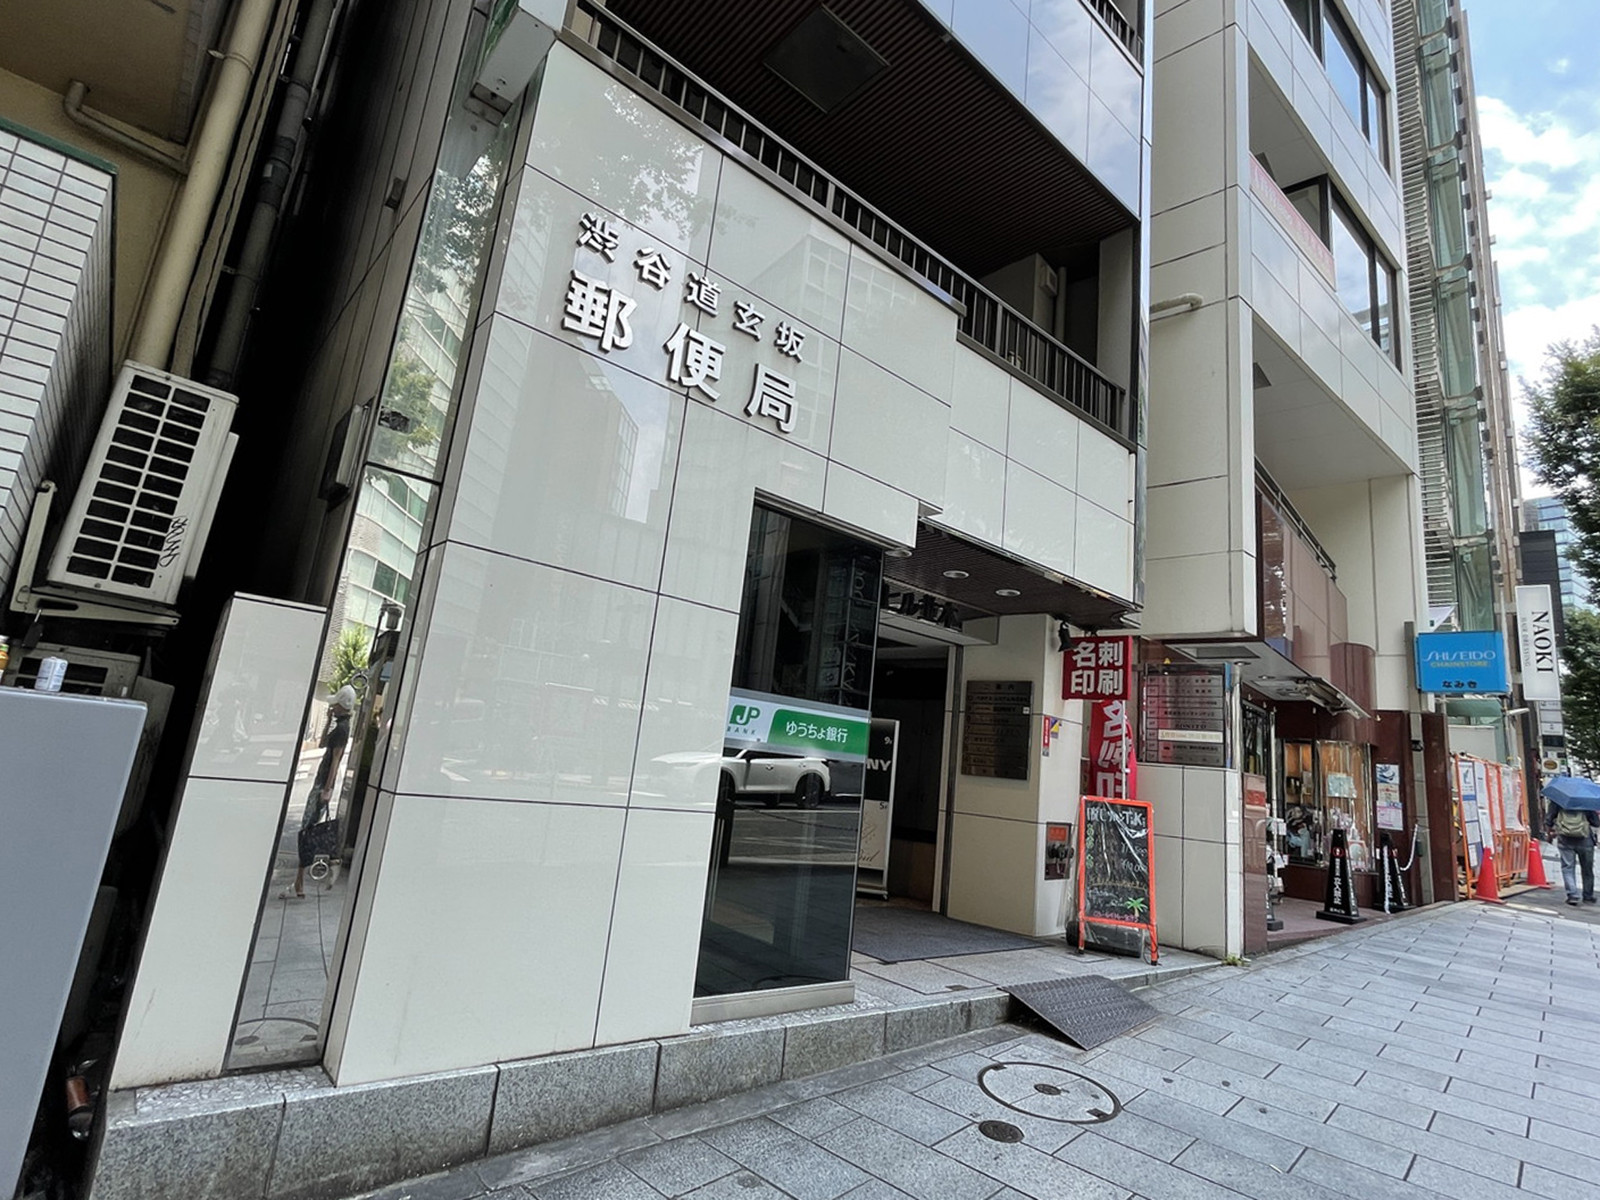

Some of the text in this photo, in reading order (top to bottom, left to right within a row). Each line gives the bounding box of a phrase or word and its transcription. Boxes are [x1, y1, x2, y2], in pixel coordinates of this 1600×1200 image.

[577, 213, 805, 362] 渋谷道玄坂
[563, 269, 798, 433] 郵便局
[1072, 641, 1124, 667] 名刺
[1531, 610, 1554, 673] NAOKI
[1422, 650, 1496, 661] SHISEIDO
[1070, 668, 1124, 695] 印刷
[730, 704, 760, 726] JP
[727, 726, 756, 735] BANK
[786, 721, 848, 743] ゆうちょ銀行
